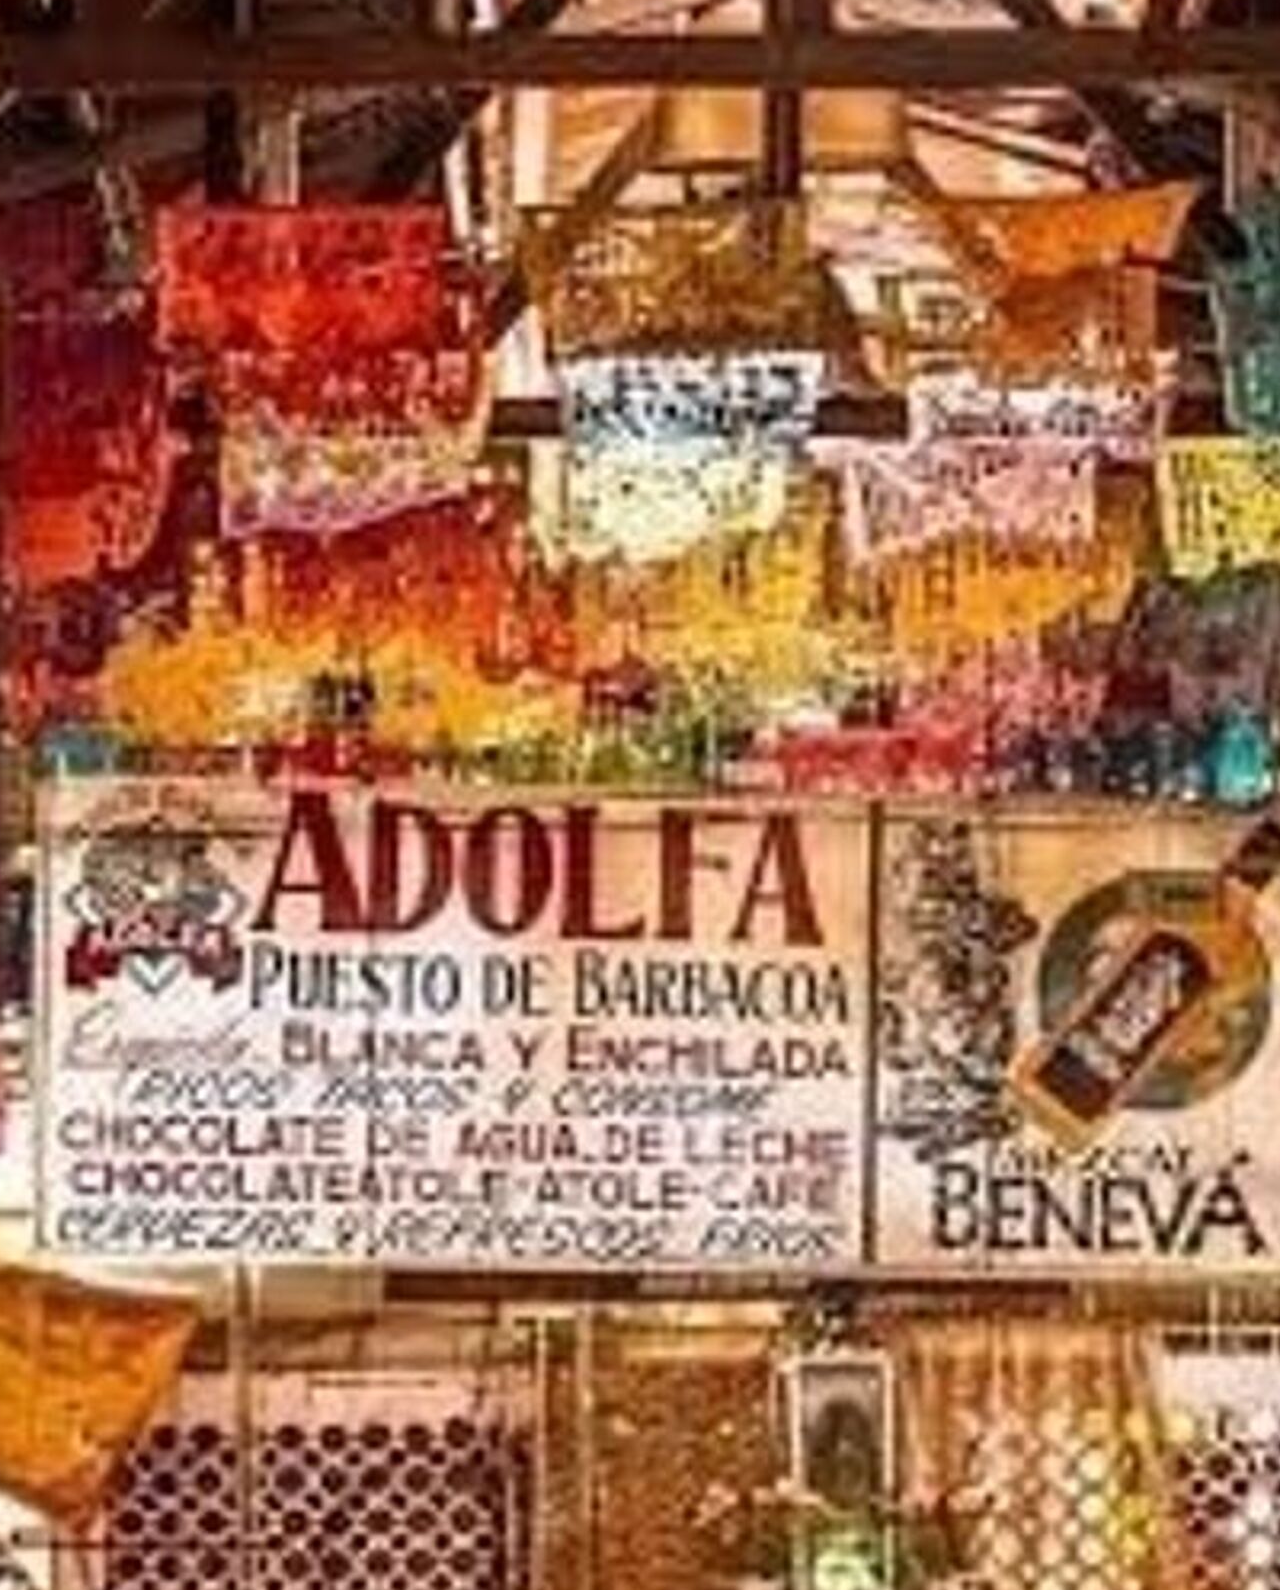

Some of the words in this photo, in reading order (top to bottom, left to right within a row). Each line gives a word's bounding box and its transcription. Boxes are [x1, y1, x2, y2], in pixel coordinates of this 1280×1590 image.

[250, 789, 825, 947] ADOLFA
[248, 943, 464, 1013] PUESTO
[481, 953, 555, 1018] DE
[573, 949, 851, 1025] BARBACOA
[281, 1023, 486, 1073] BLANCA
[509, 1029, 542, 1073] Y
[565, 1025, 852, 1079] ENCHILADA
[58, 1111, 347, 1157] CHOCOLATE
[367, 1115, 432, 1157] DE
[682, 1131, 852, 1169] LECHE
